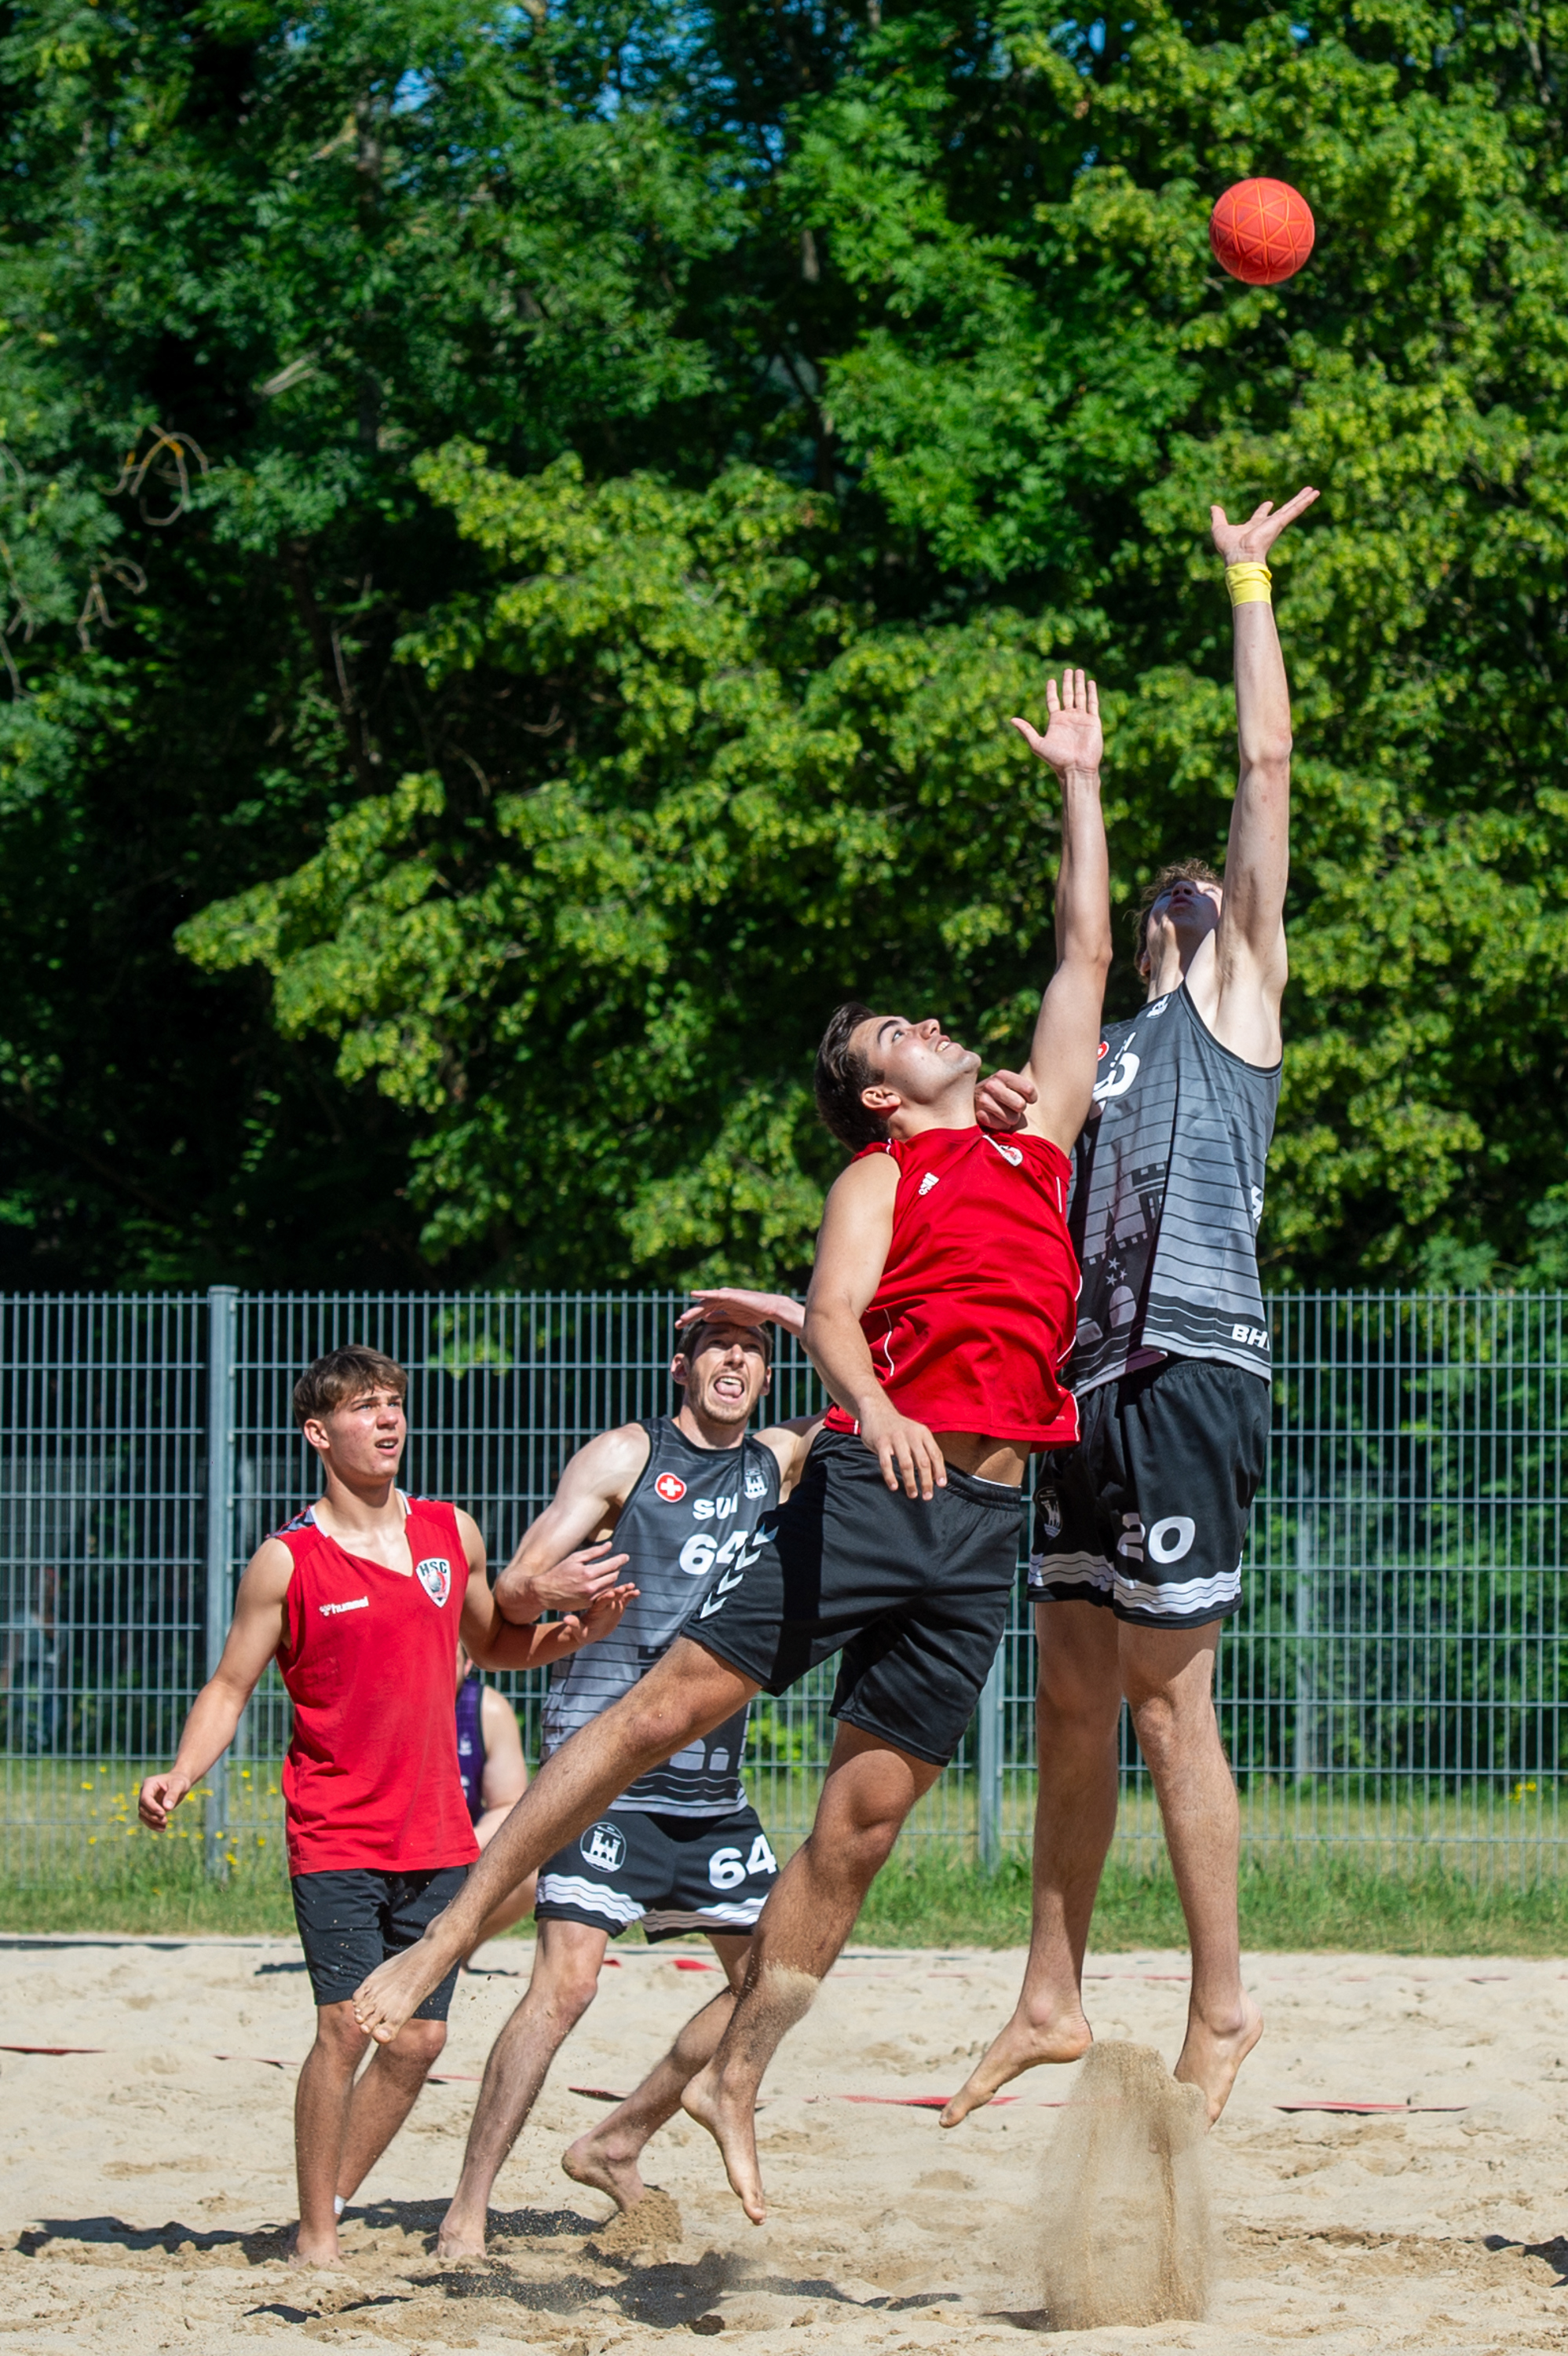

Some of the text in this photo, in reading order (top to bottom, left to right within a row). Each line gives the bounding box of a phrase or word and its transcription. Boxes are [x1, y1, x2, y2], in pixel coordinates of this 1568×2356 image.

[693, 1492, 738, 1520] SUI
[679, 1531, 748, 1575] 64
[1117, 1513, 1196, 1564] 20
[419, 1561, 447, 1576] HSC
[709, 1834, 777, 1890] 64
